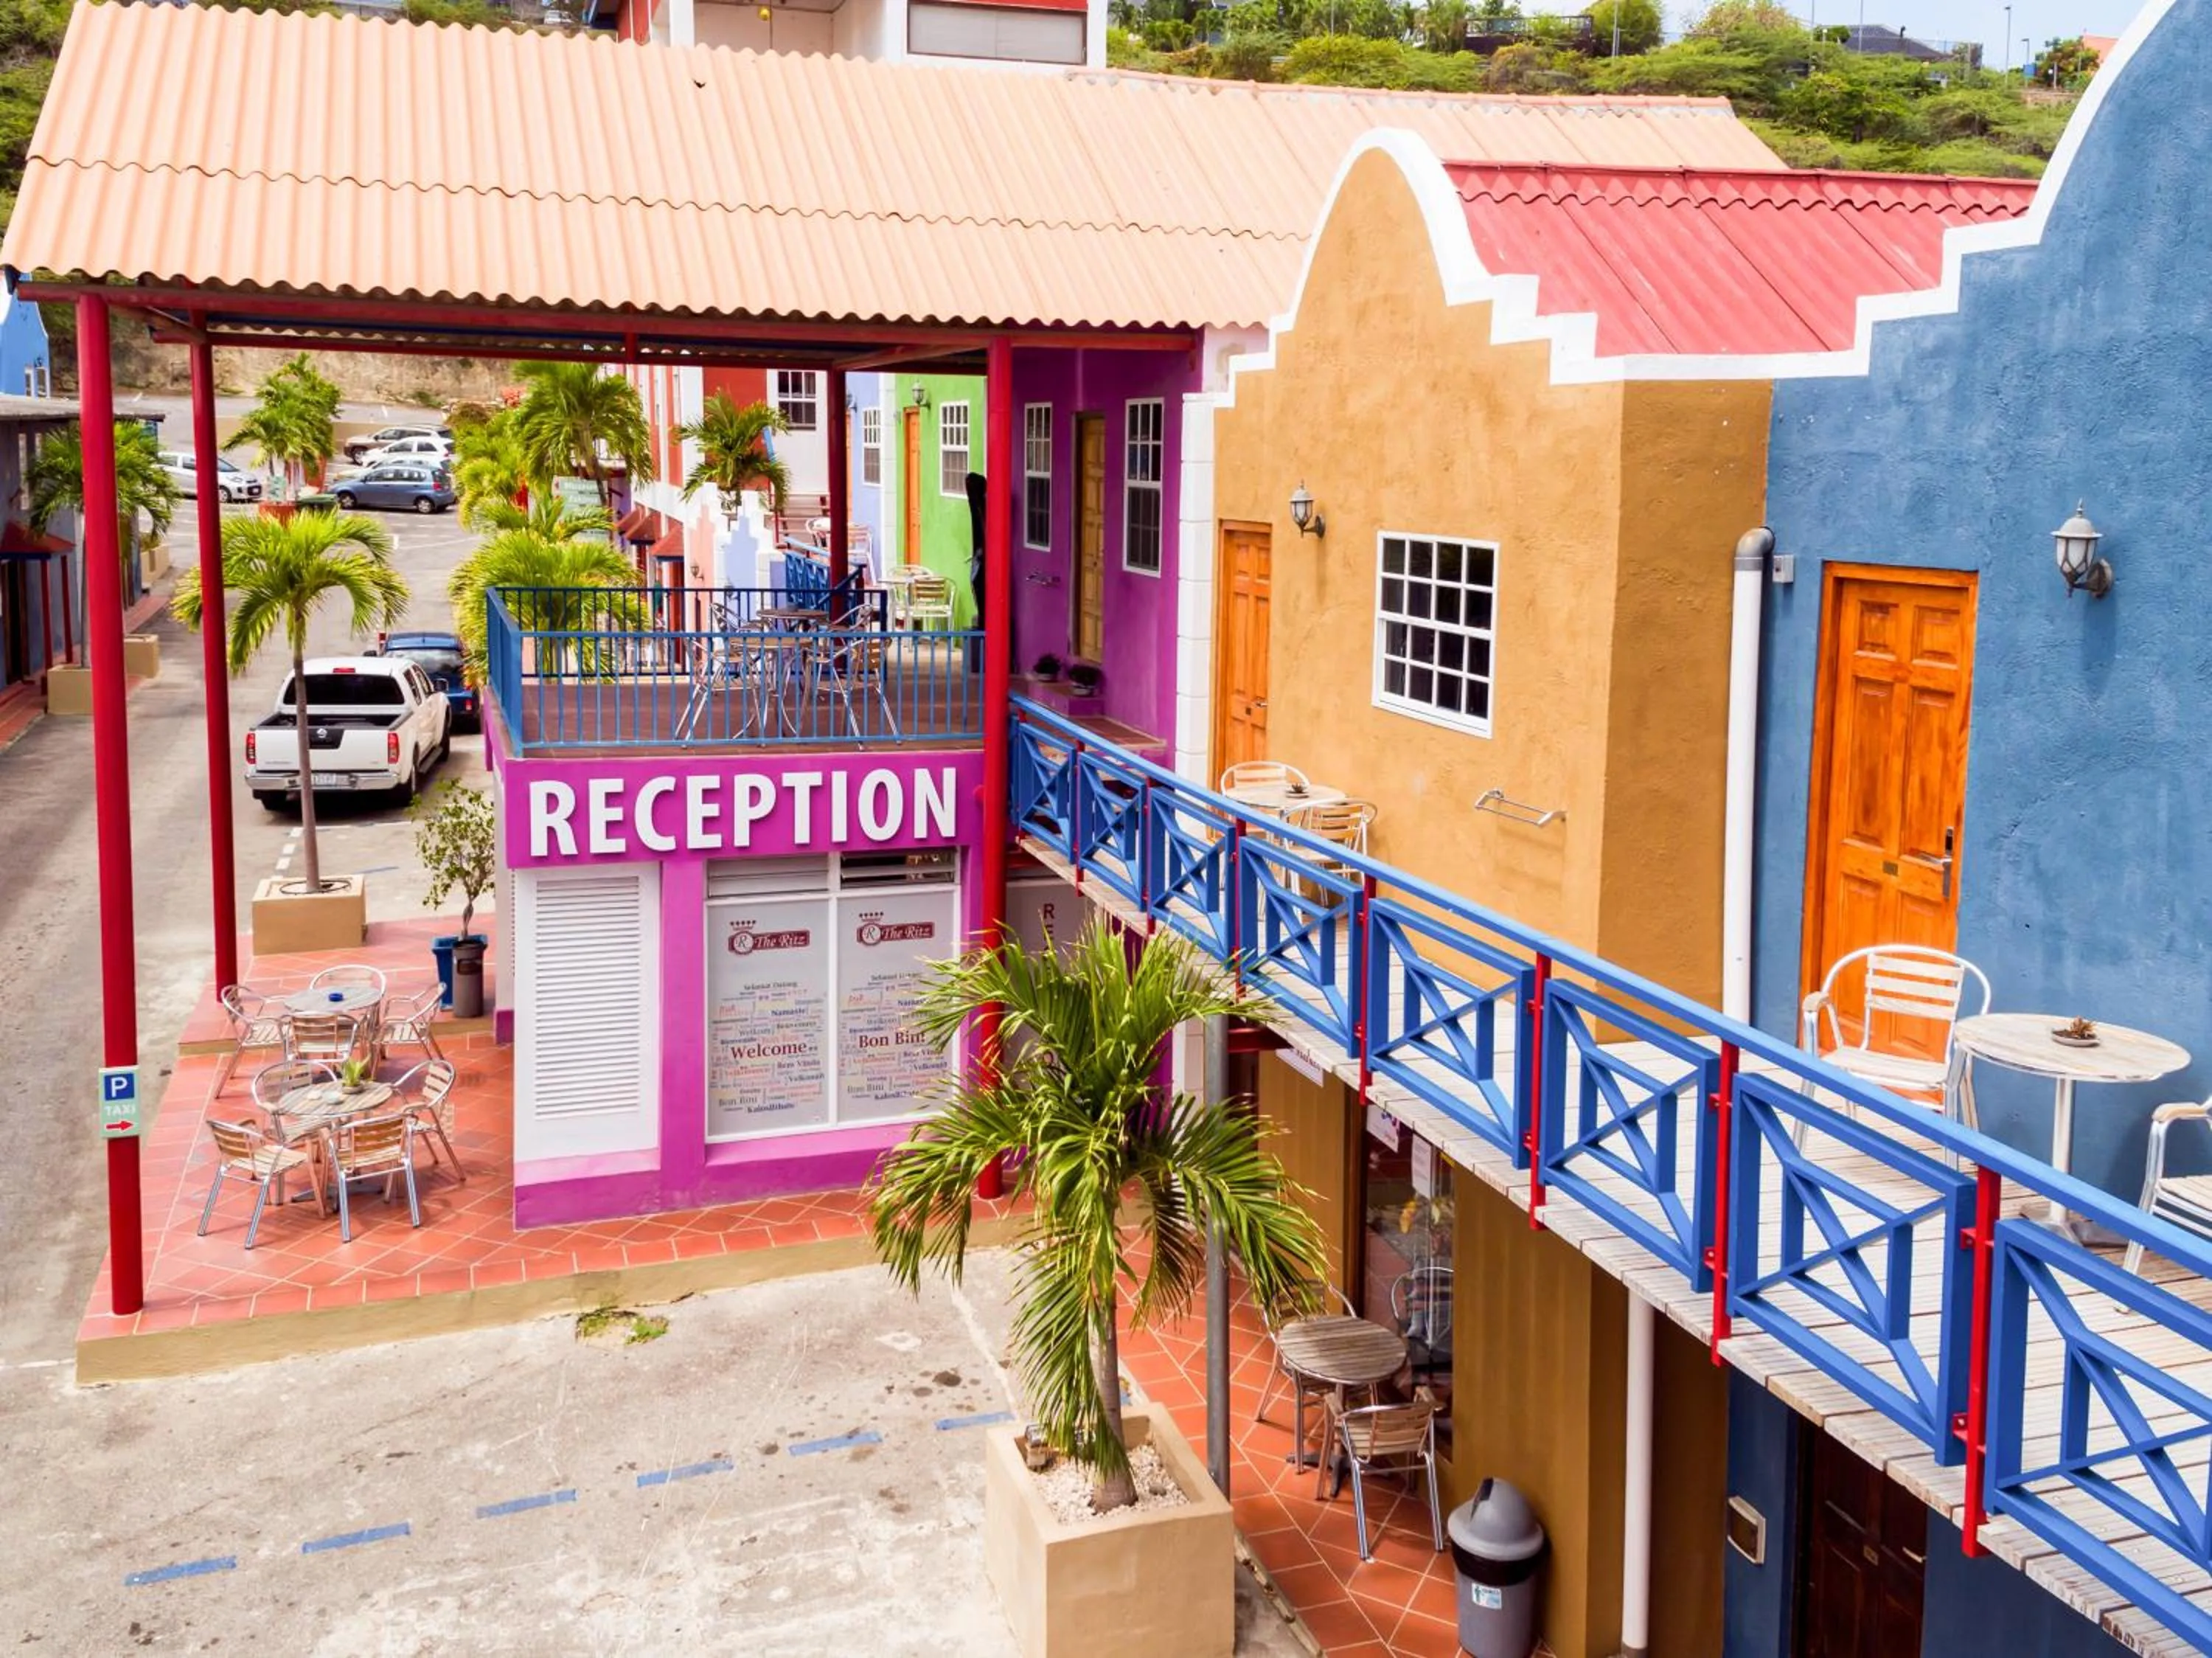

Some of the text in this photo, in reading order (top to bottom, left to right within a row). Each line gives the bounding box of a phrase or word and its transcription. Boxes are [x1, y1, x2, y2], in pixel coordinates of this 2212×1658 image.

[529, 767, 956, 857] RECEPTION
[882, 926, 903, 939] The
[905, 925, 930, 939] Ritz
[754, 935, 776, 948] The
[779, 933, 805, 948] Ritz
[858, 1034, 889, 1049] Bon
[730, 1041, 807, 1060] Welcome
[111, 1076, 128, 1098] P
[104, 1104, 136, 1117] TAXI
